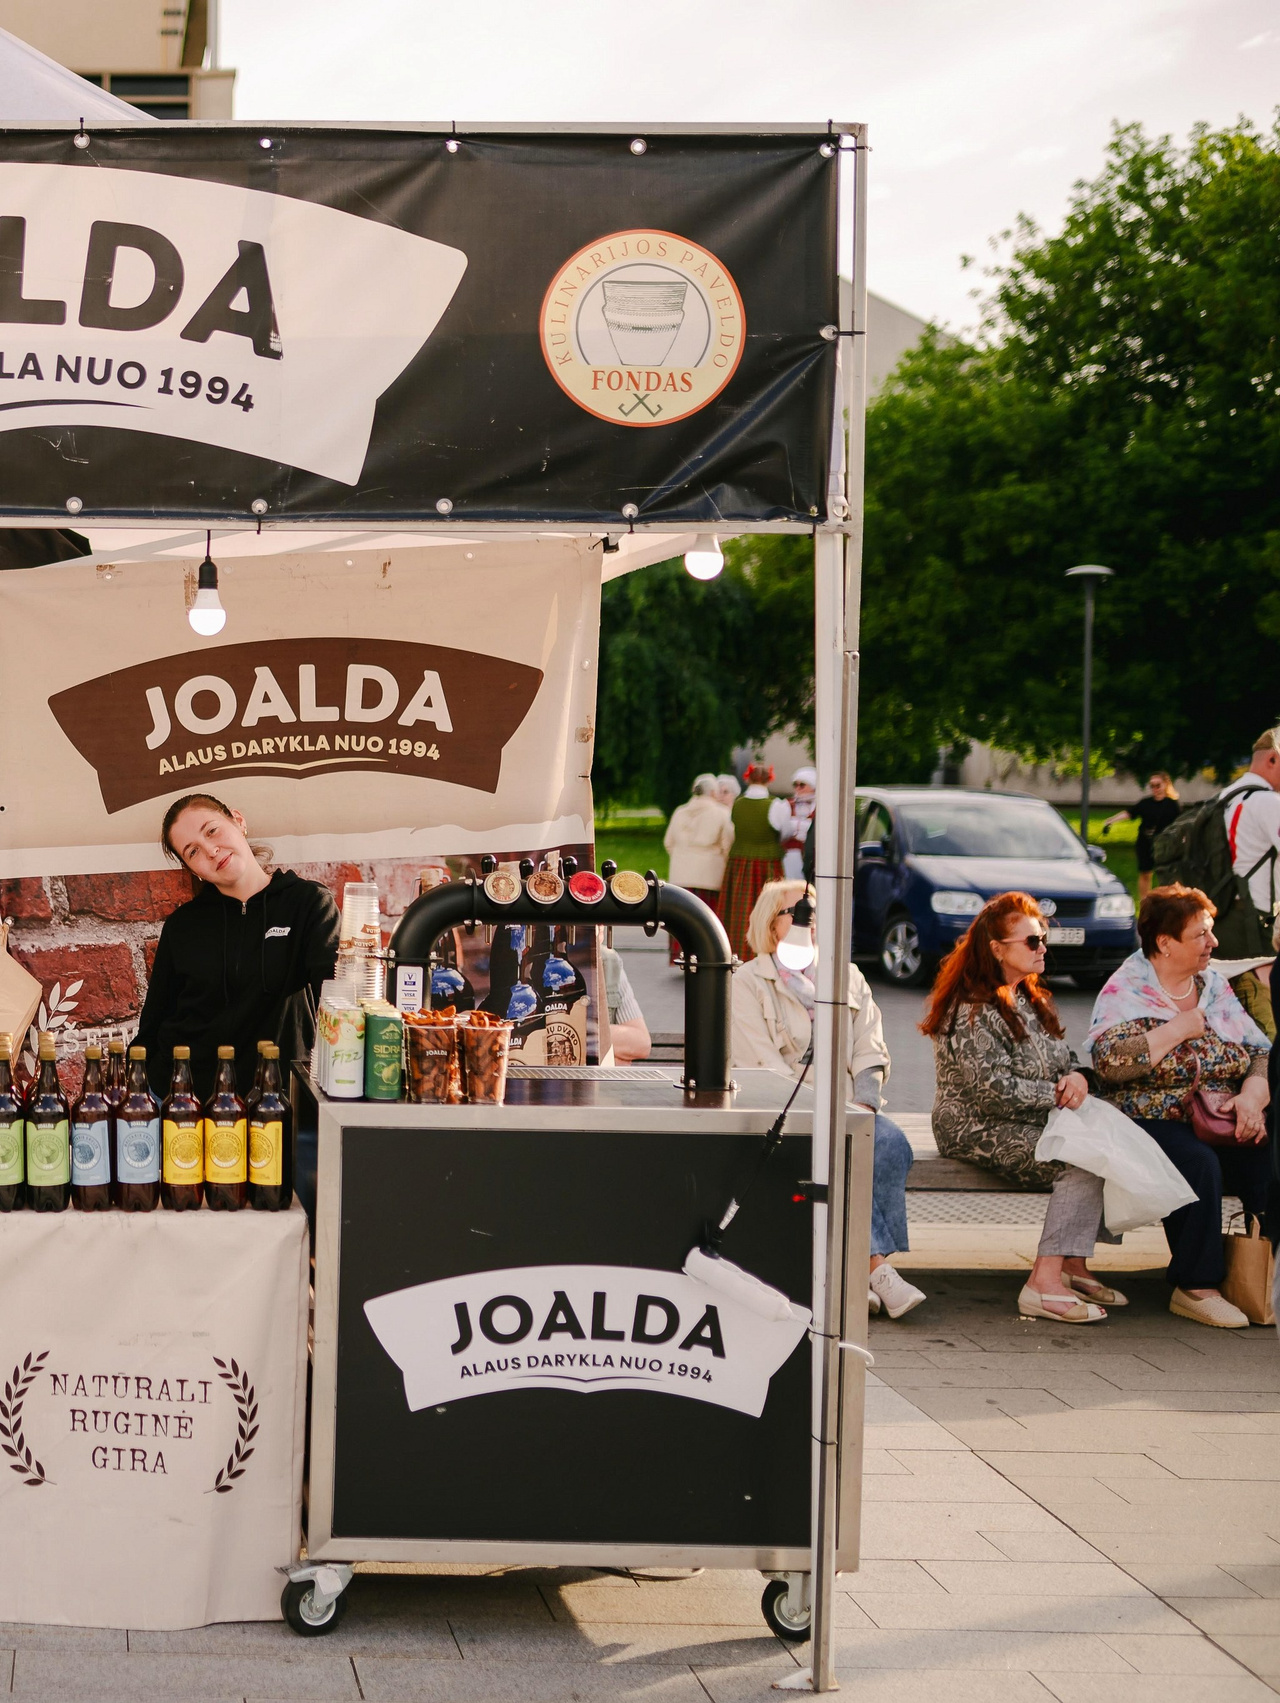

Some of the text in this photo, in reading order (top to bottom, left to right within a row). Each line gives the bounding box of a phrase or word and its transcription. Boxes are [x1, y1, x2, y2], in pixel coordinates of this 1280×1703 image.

[550, 239, 736, 369] KULINARIJOS PAVELDO
[55, 354, 147, 389] NUO
[157, 366, 255, 413] 1994
[591, 369, 693, 393] FONDAS
[145, 663, 454, 750] JOALDA
[158, 734, 440, 775] ALAUS DARYKLA NUO 1994
[545, 1003, 568, 1012] OALDA
[557, 1025, 578, 1046] DVARO
[450, 1290, 726, 1359] JOALDA
[460, 1353, 713, 1383] ALAUS DARYKLA NUO 1994
[49, 1372, 213, 1404] NATŪRALI
[69, 1408, 194, 1439] RUGINĖ
[91, 1446, 169, 1475] GIRA
